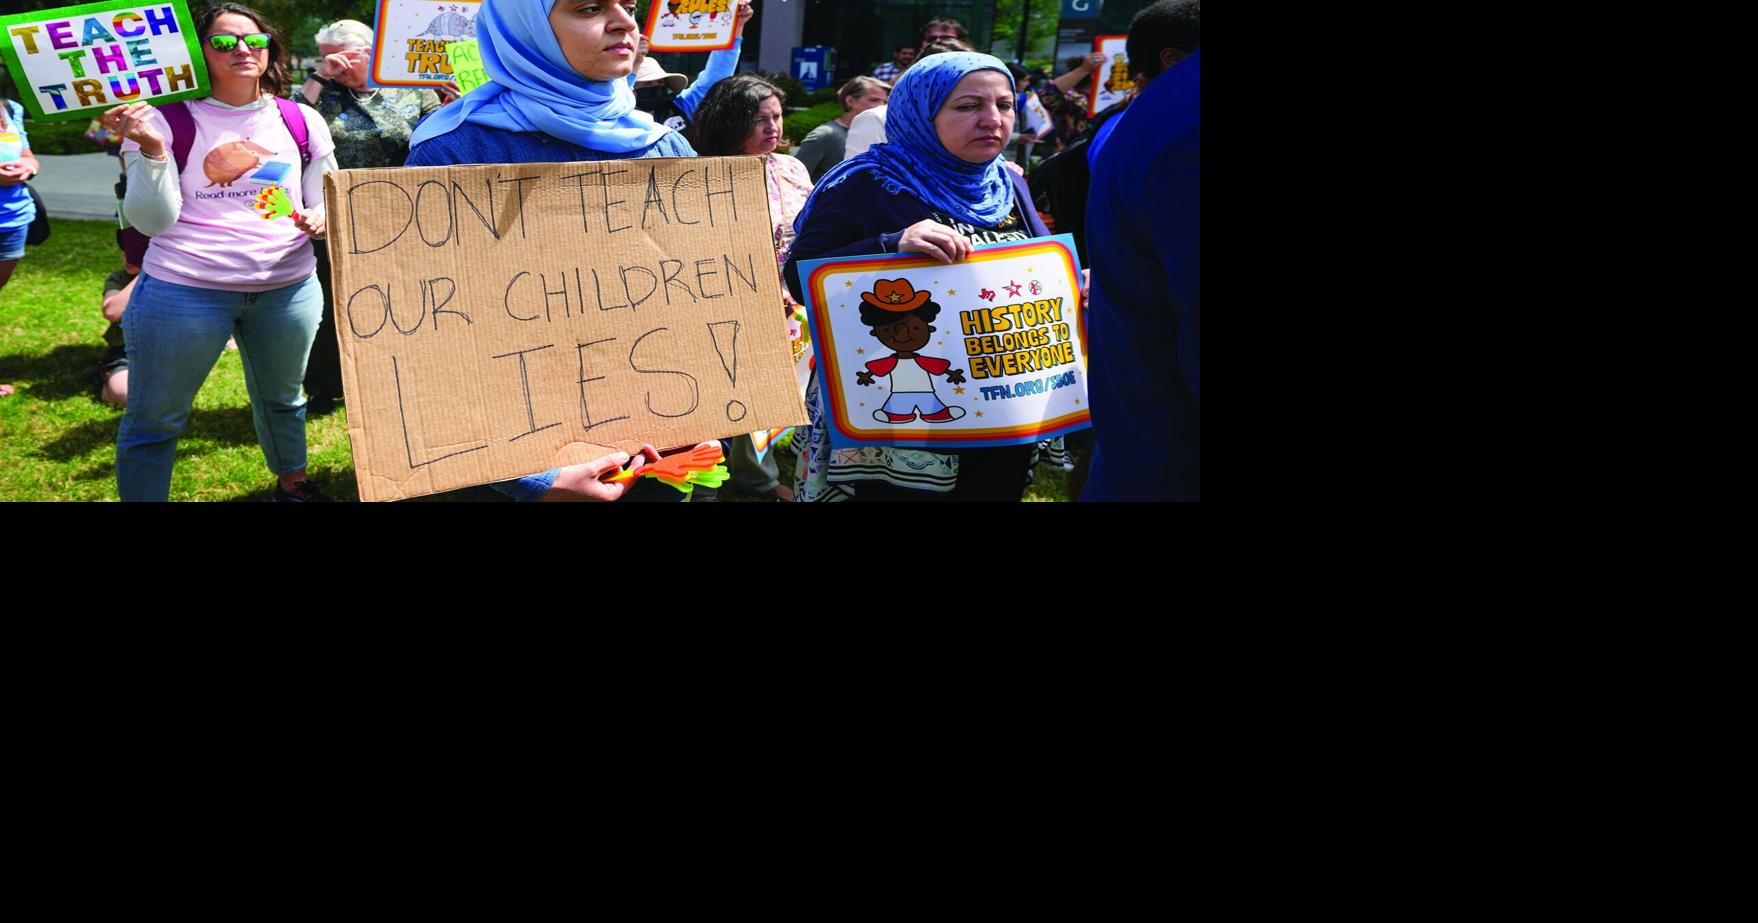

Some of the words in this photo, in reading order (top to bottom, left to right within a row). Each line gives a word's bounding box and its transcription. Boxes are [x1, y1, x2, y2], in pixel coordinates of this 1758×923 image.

[10, 6, 178, 55] TEACH
[407, 38, 457, 53] TEAC
[58, 38, 158, 78] THE
[39, 64, 195, 110] TRUTH
[195, 191, 224, 200] Read
[228, 189, 257, 198] more
[348, 172, 540, 254] DON'T
[561, 165, 738, 233] TEACH
[347, 276, 473, 339] OUR
[504, 254, 757, 322] CHILDREN
[960, 297, 1063, 336] HISTORY
[964, 329, 1050, 356] BELONGS
[1051, 322, 1070, 342] TO
[968, 341, 1076, 380] EVERYONE
[392, 320, 747, 469] LIES!
[980, 371, 1077, 401] TFN.ORG/SBOE
